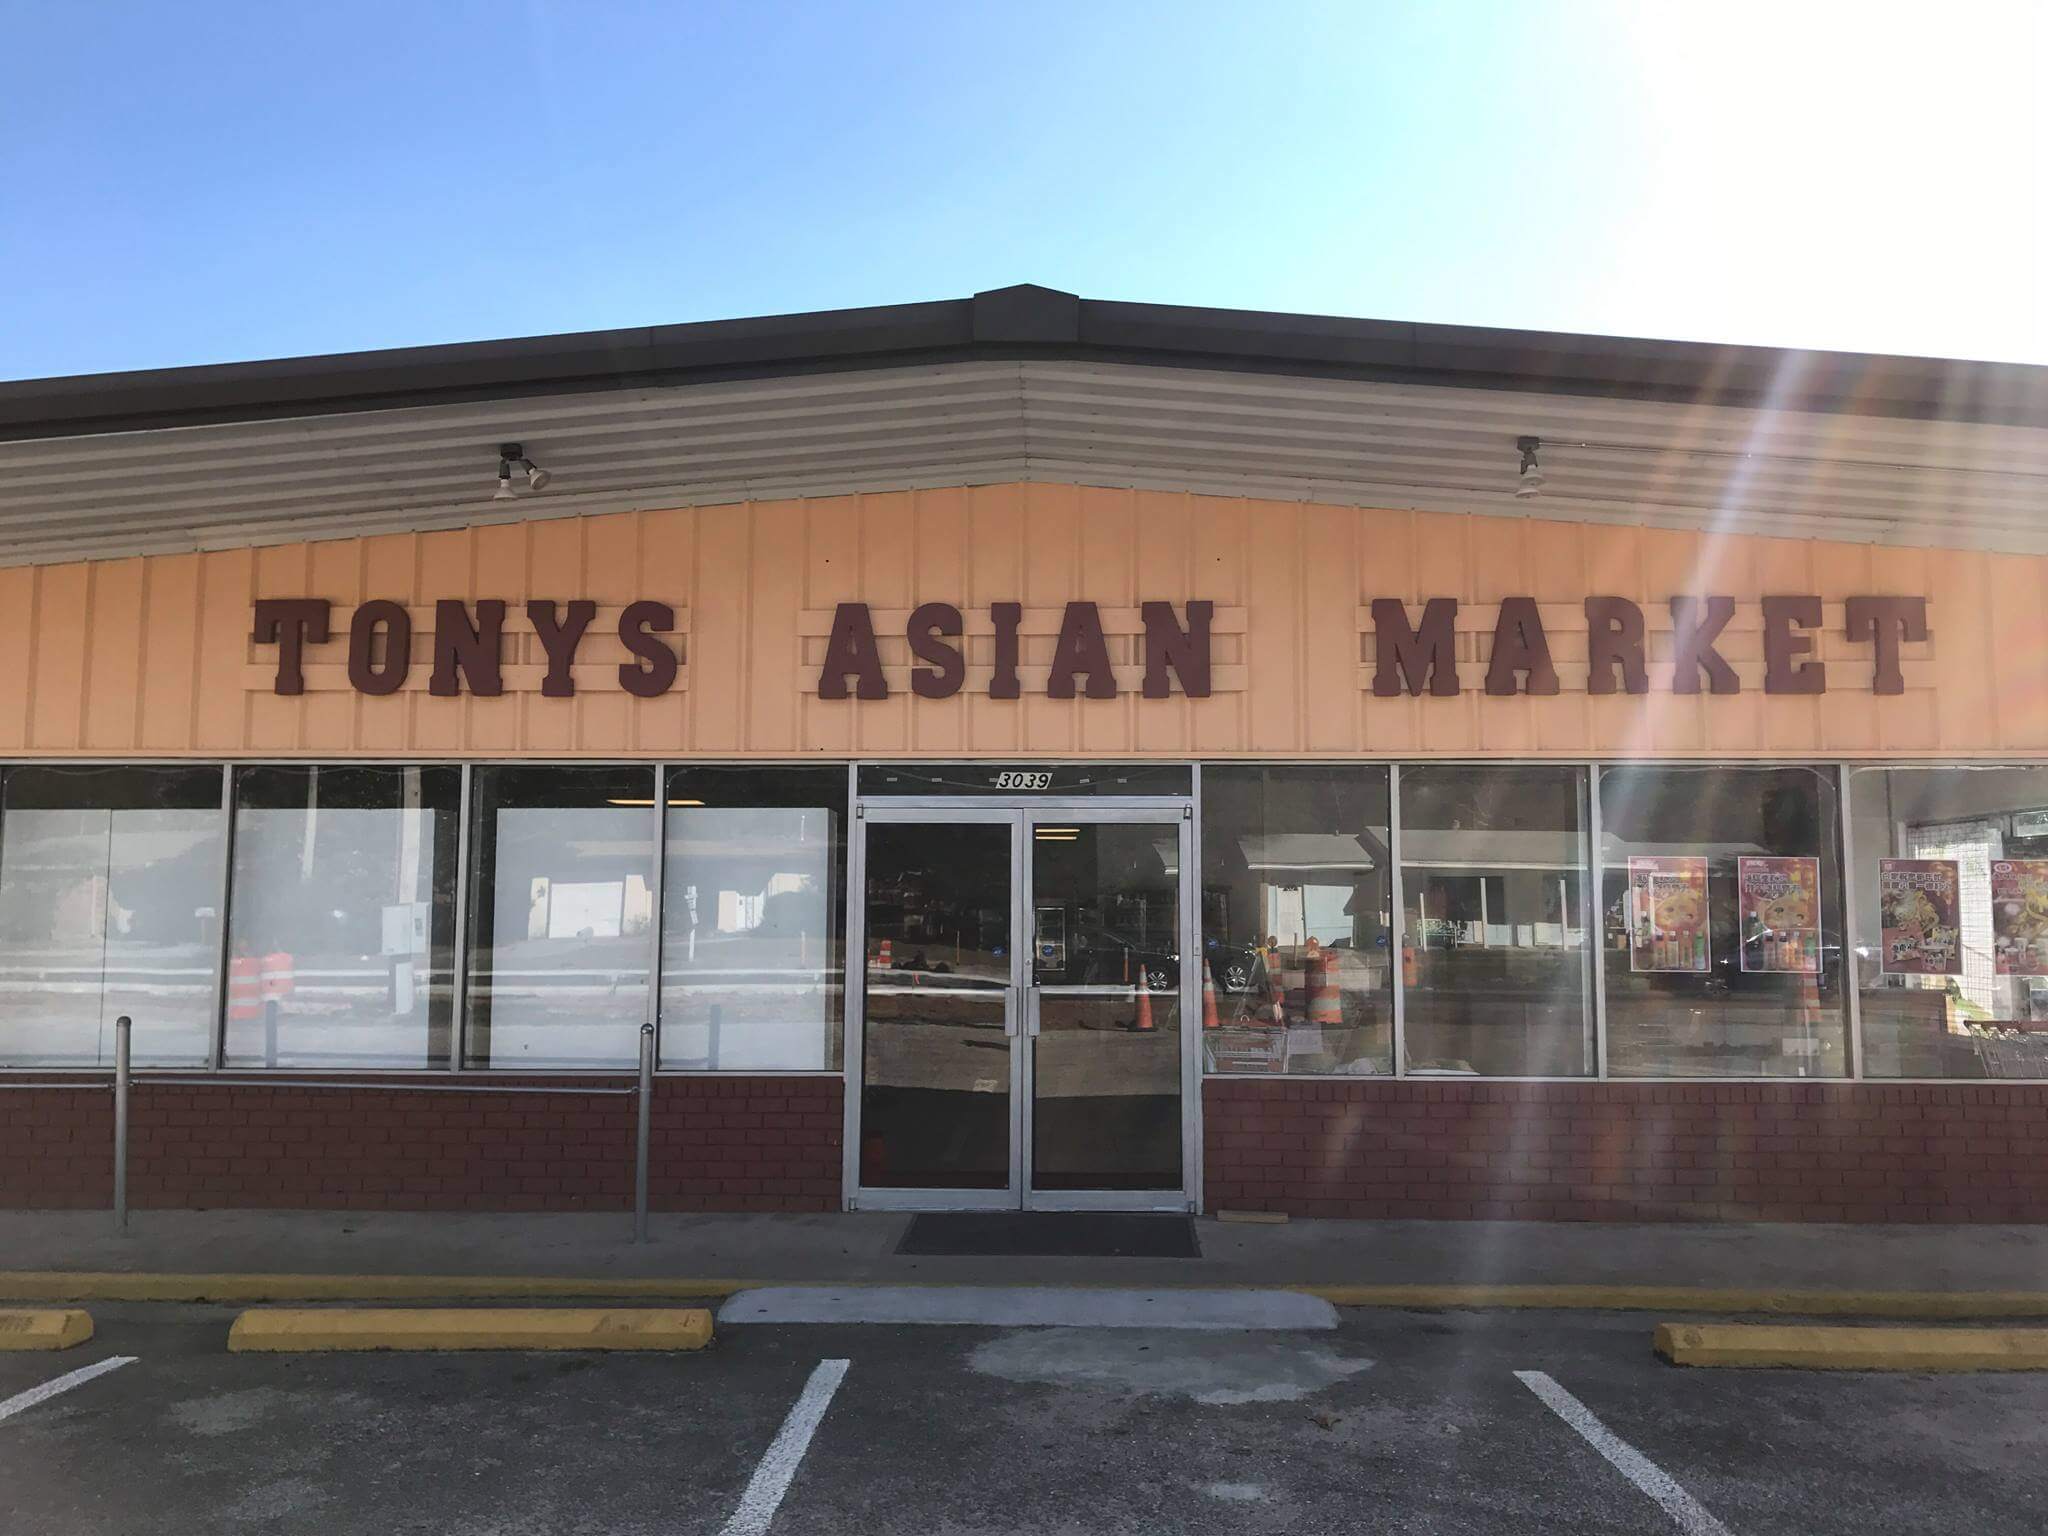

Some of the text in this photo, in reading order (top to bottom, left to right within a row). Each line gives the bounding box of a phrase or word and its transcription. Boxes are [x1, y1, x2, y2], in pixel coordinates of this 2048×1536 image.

[254, 596, 1926, 699] TONYS ASIAN MARKET
[999, 773, 1049, 788] 3039
